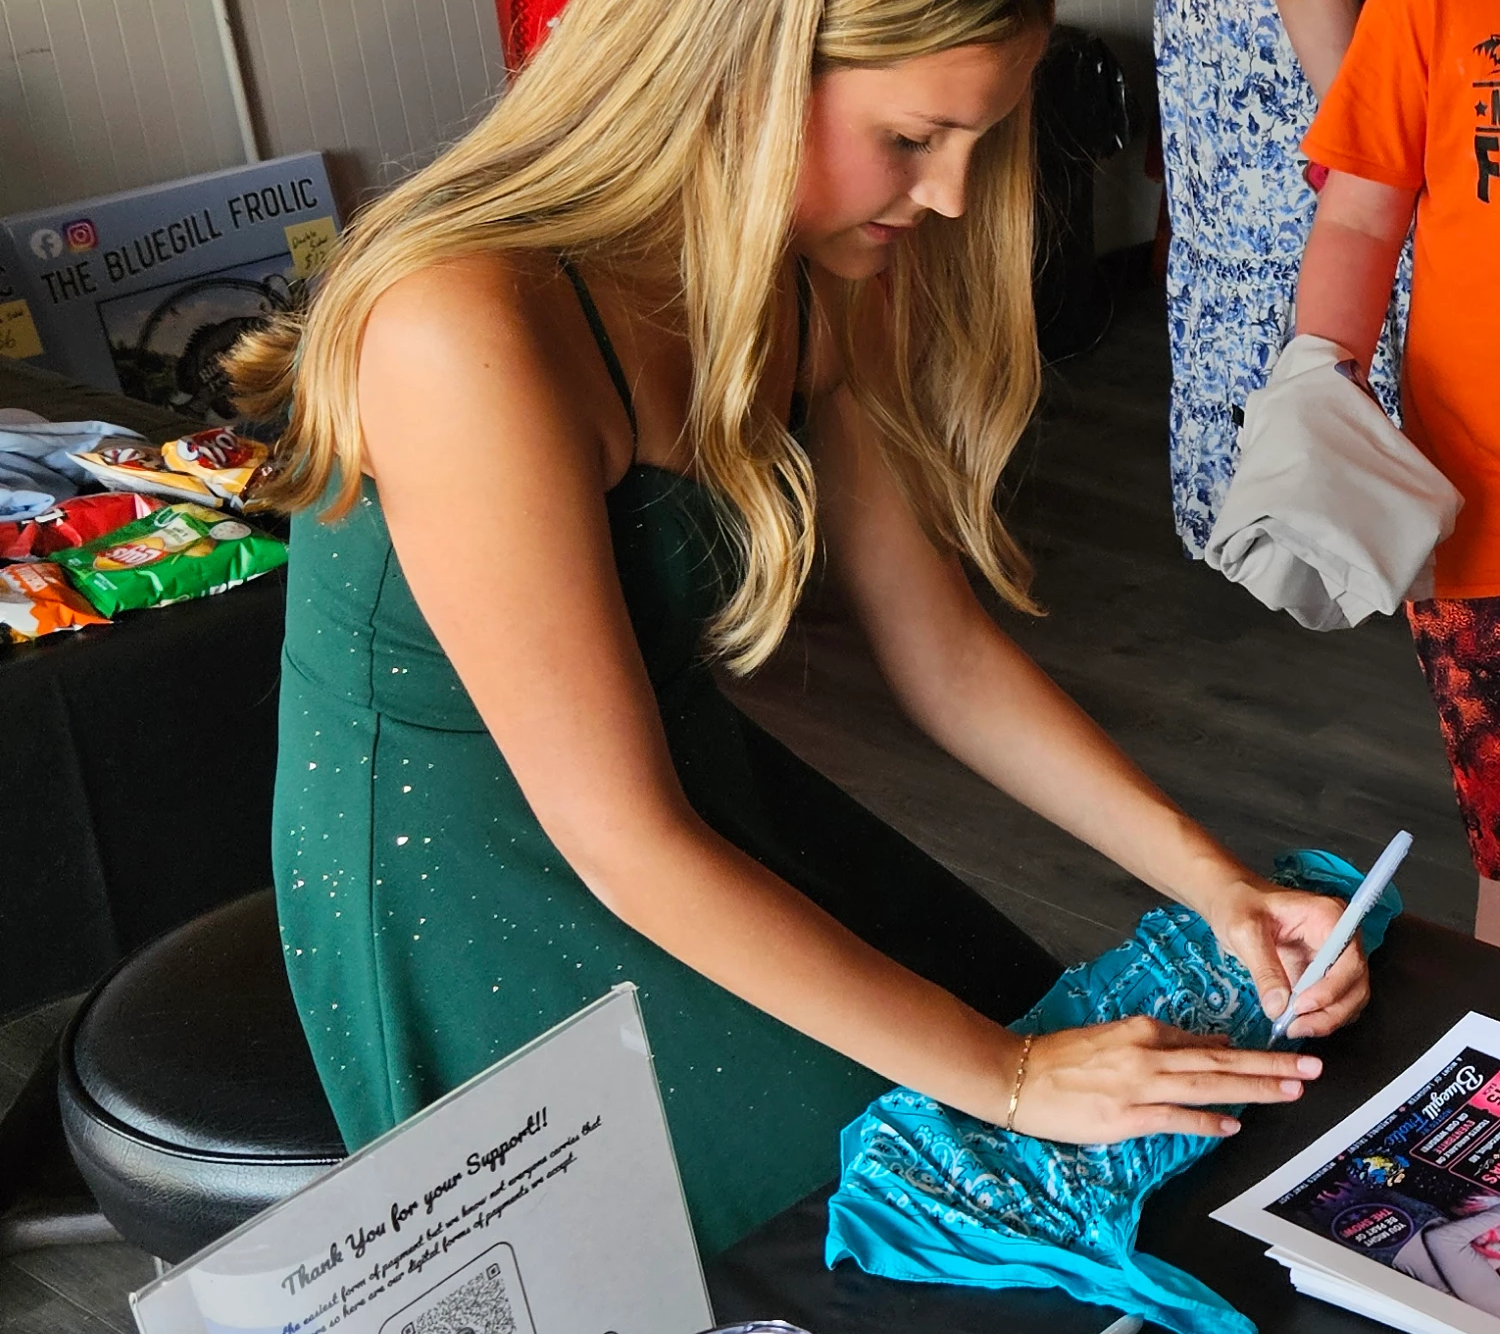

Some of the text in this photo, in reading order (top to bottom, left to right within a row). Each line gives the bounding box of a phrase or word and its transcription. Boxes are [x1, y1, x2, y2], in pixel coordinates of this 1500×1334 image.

[41, 266, 97, 306] THE
[104, 208, 223, 286] BLUEGILL
[228, 177, 319, 230] FROLIC
[1384, 1066, 1483, 1145] Bluegill Frolic
[282, 1107, 548, 1295] Thank You for your Support!!
[303, 1292, 339, 1325] easiest
[340, 1278, 367, 1304] form
[368, 1262, 381, 1281] of
[382, 1235, 424, 1278] payment
[426, 1222, 443, 1241] but
[445, 1216, 460, 1228] we
[460, 1196, 487, 1218] know
[490, 1180, 505, 1199] not
[508, 1156, 547, 1186] everyone
[581, 1115, 601, 1136] that
[328, 1315, 341, 1328] so
[342, 1298, 367, 1319] here
[367, 1285, 386, 1301] are
[386, 1271, 405, 1288] our
[408, 1242, 440, 1274] digital
[441, 1227, 472, 1254] forms
[472, 1211, 485, 1230] of
[485, 1185, 529, 1227] payments
[531, 1177, 544, 1189] we
[1355, 1216, 1398, 1242] BE PART OF
[1364, 1222, 1407, 1247] YOU MIGHT
[1371, 1209, 1393, 1222] THE
